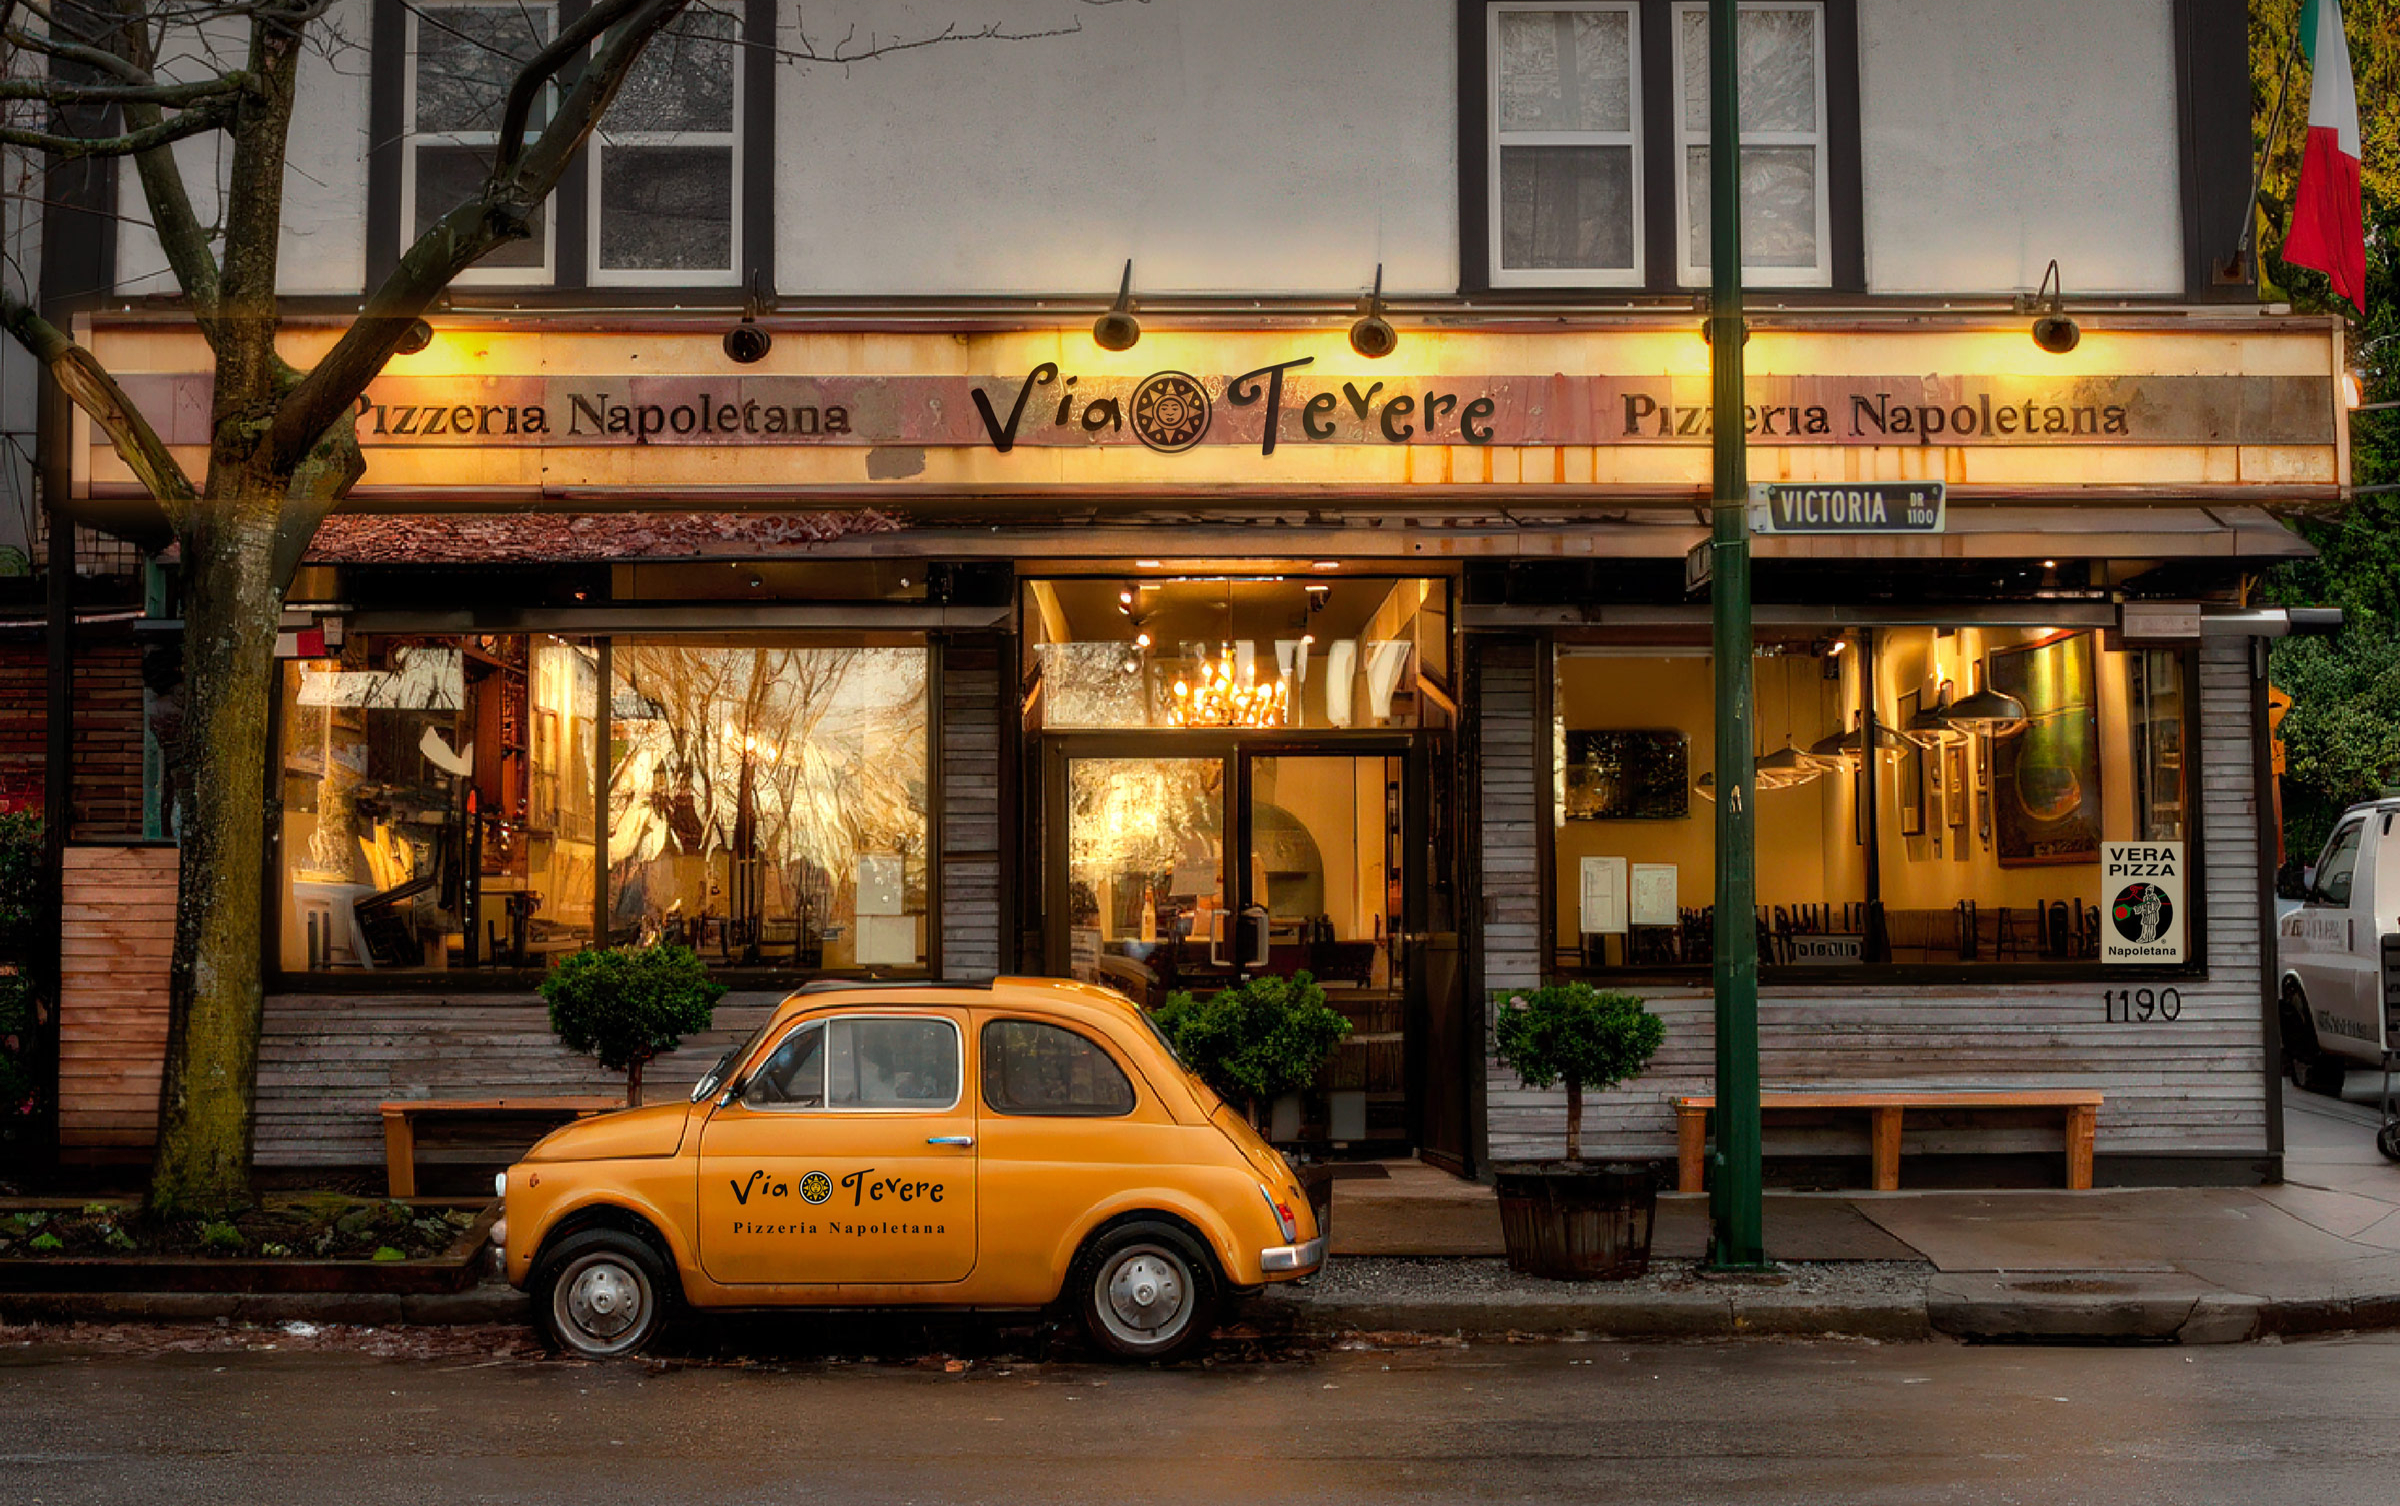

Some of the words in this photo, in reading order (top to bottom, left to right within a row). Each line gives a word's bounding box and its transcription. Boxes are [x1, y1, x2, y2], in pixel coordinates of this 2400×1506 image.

[567, 393, 852, 445] Napoletana
[971, 362, 1121, 453] Via
[1227, 356, 1495, 456] Tevere
[1848, 393, 2129, 445] Napoletana
[1780, 491, 1887, 523] VICTORIA
[1910, 492, 1925, 508] DR
[1907, 509, 1934, 524] 1100
[2109, 848, 2176, 861] VERA
[2109, 864, 2176, 876] PIZZA
[2108, 946, 2177, 958] Napoletana
[2103, 987, 2181, 1022] 1190
[730, 1169, 788, 1205] Via
[841, 1168, 944, 1207] Tevere
[733, 1221, 818, 1234] Pizzeria
[829, 1221, 945, 1237] Napoletana
